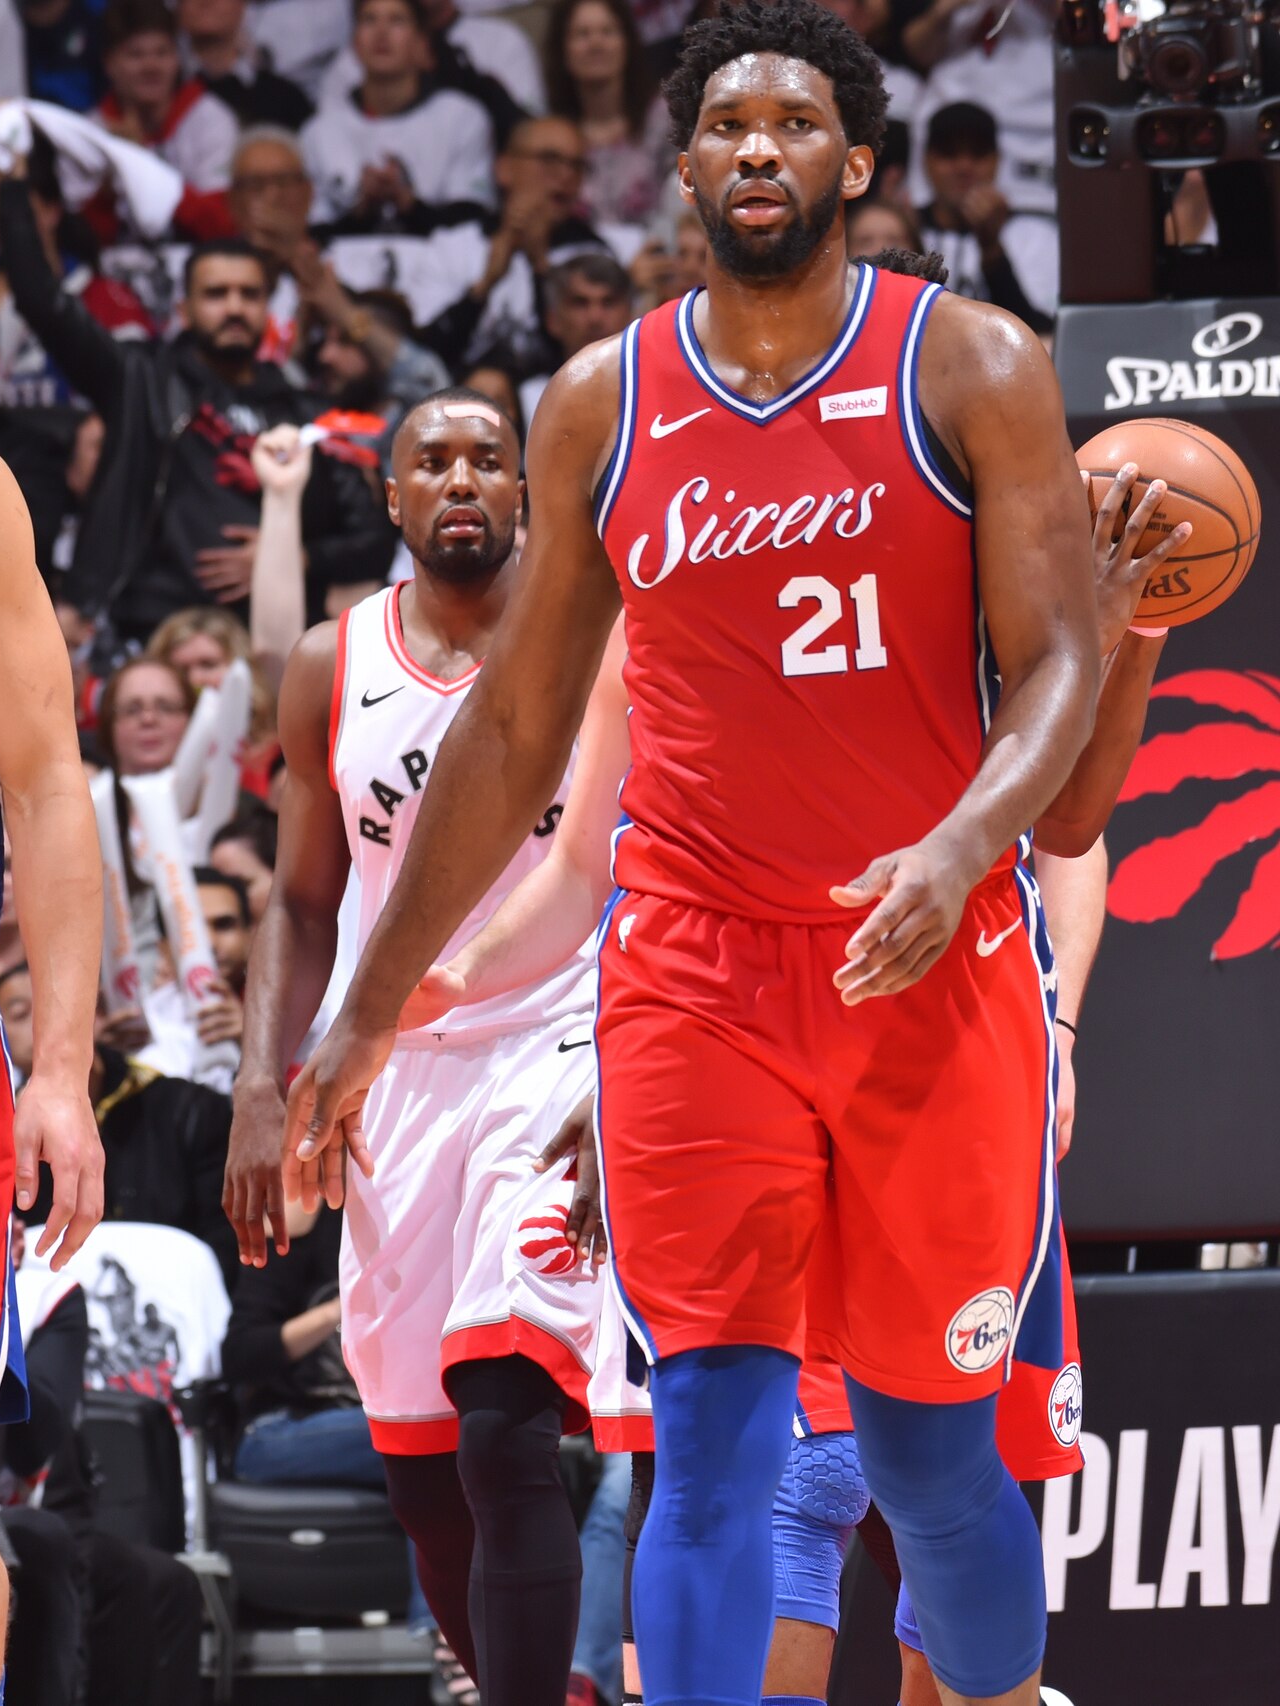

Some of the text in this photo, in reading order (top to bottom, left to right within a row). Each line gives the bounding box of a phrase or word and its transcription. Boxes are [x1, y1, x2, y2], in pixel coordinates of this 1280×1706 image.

[827, 398, 878, 414] StubHub
[627, 475, 887, 590] Sixers
[777, 573, 888, 678] 21
